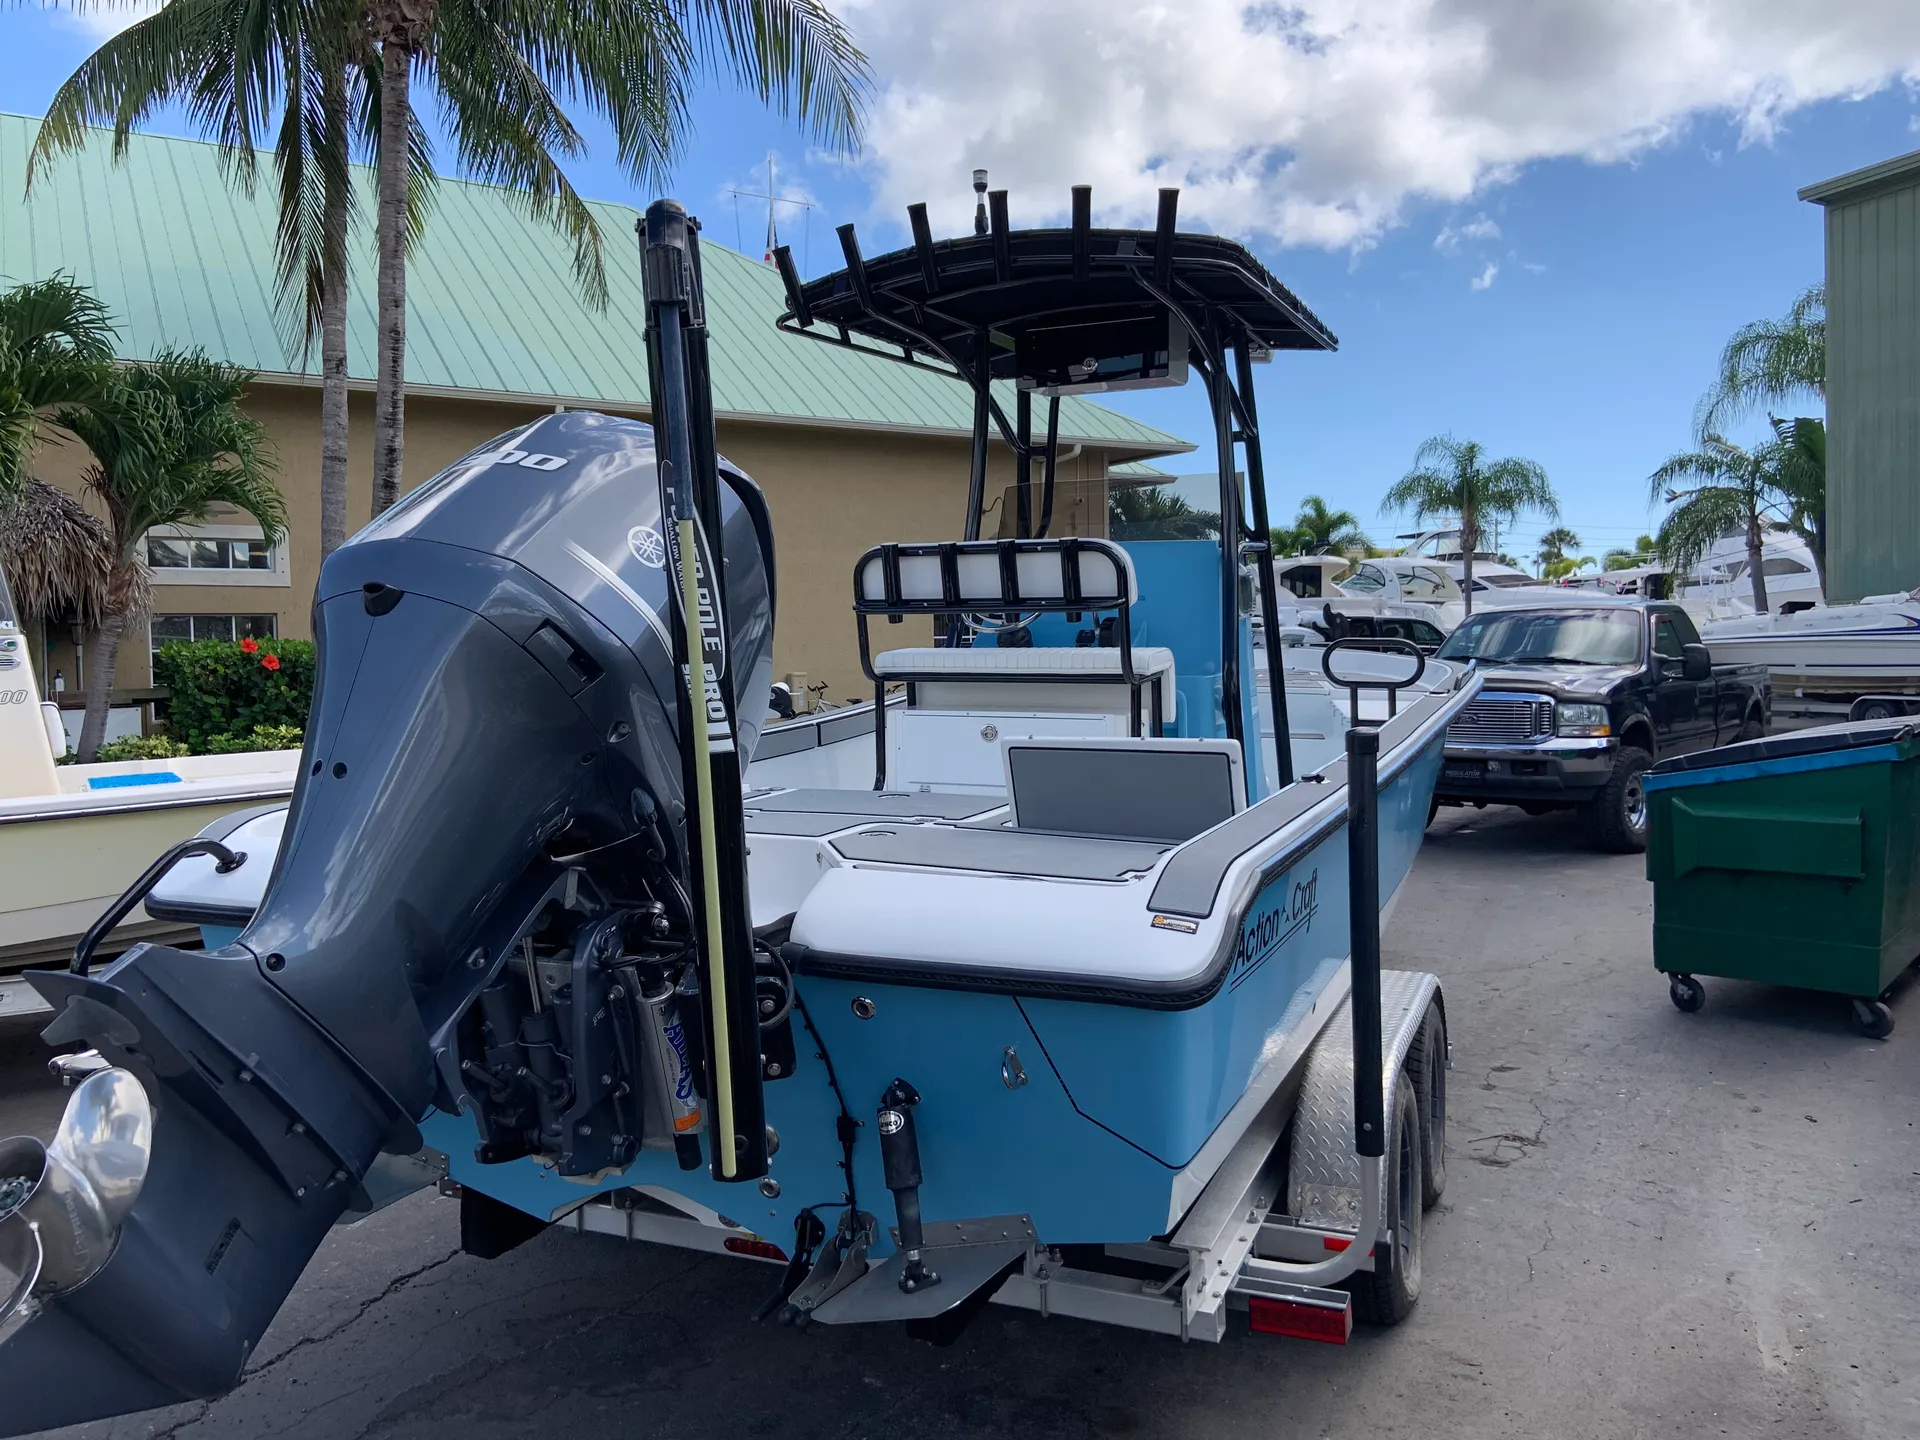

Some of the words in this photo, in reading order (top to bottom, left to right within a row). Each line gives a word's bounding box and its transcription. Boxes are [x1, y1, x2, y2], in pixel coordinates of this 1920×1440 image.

[666, 517, 680, 559] SHALLOW
[1233, 908, 1279, 974] Action
[1292, 868, 1318, 933] Craft
